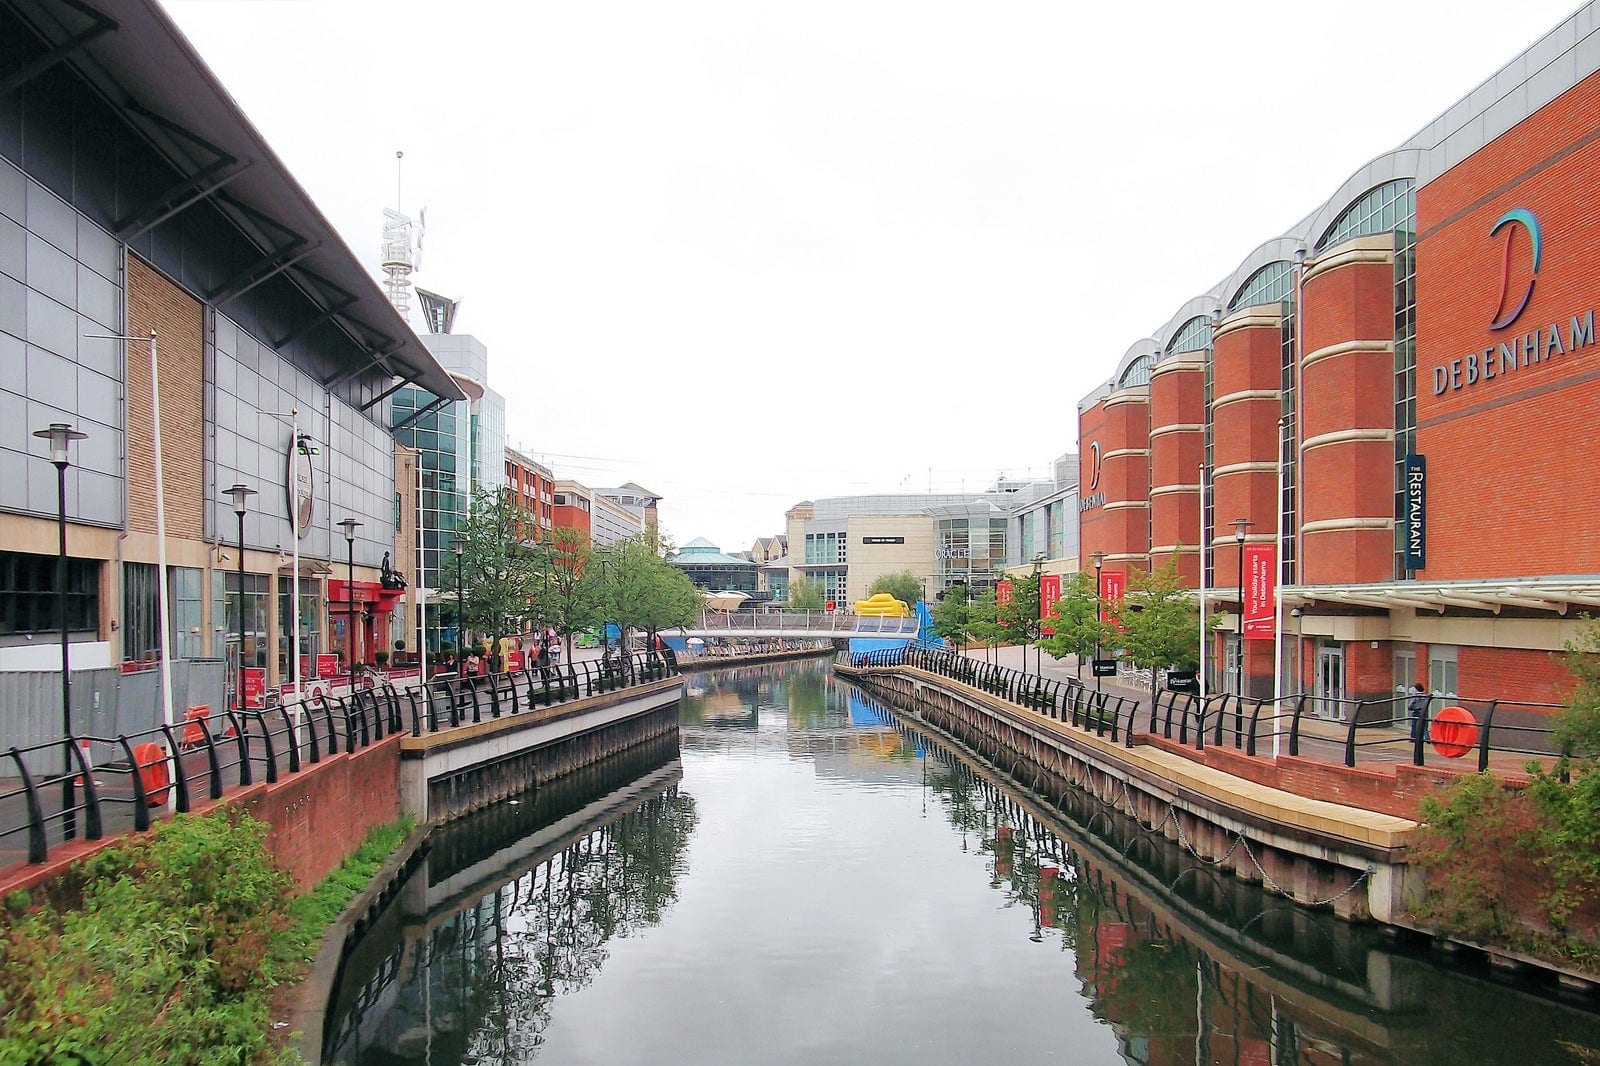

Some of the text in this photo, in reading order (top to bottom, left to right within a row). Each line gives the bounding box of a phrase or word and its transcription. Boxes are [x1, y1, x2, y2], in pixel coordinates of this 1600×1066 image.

[1433, 310, 1596, 396] DEBENHAM
[1408, 472, 1423, 558] RESTAURANT
[935, 548, 970, 560] ORACLE
[1251, 575, 1259, 599] holiday
